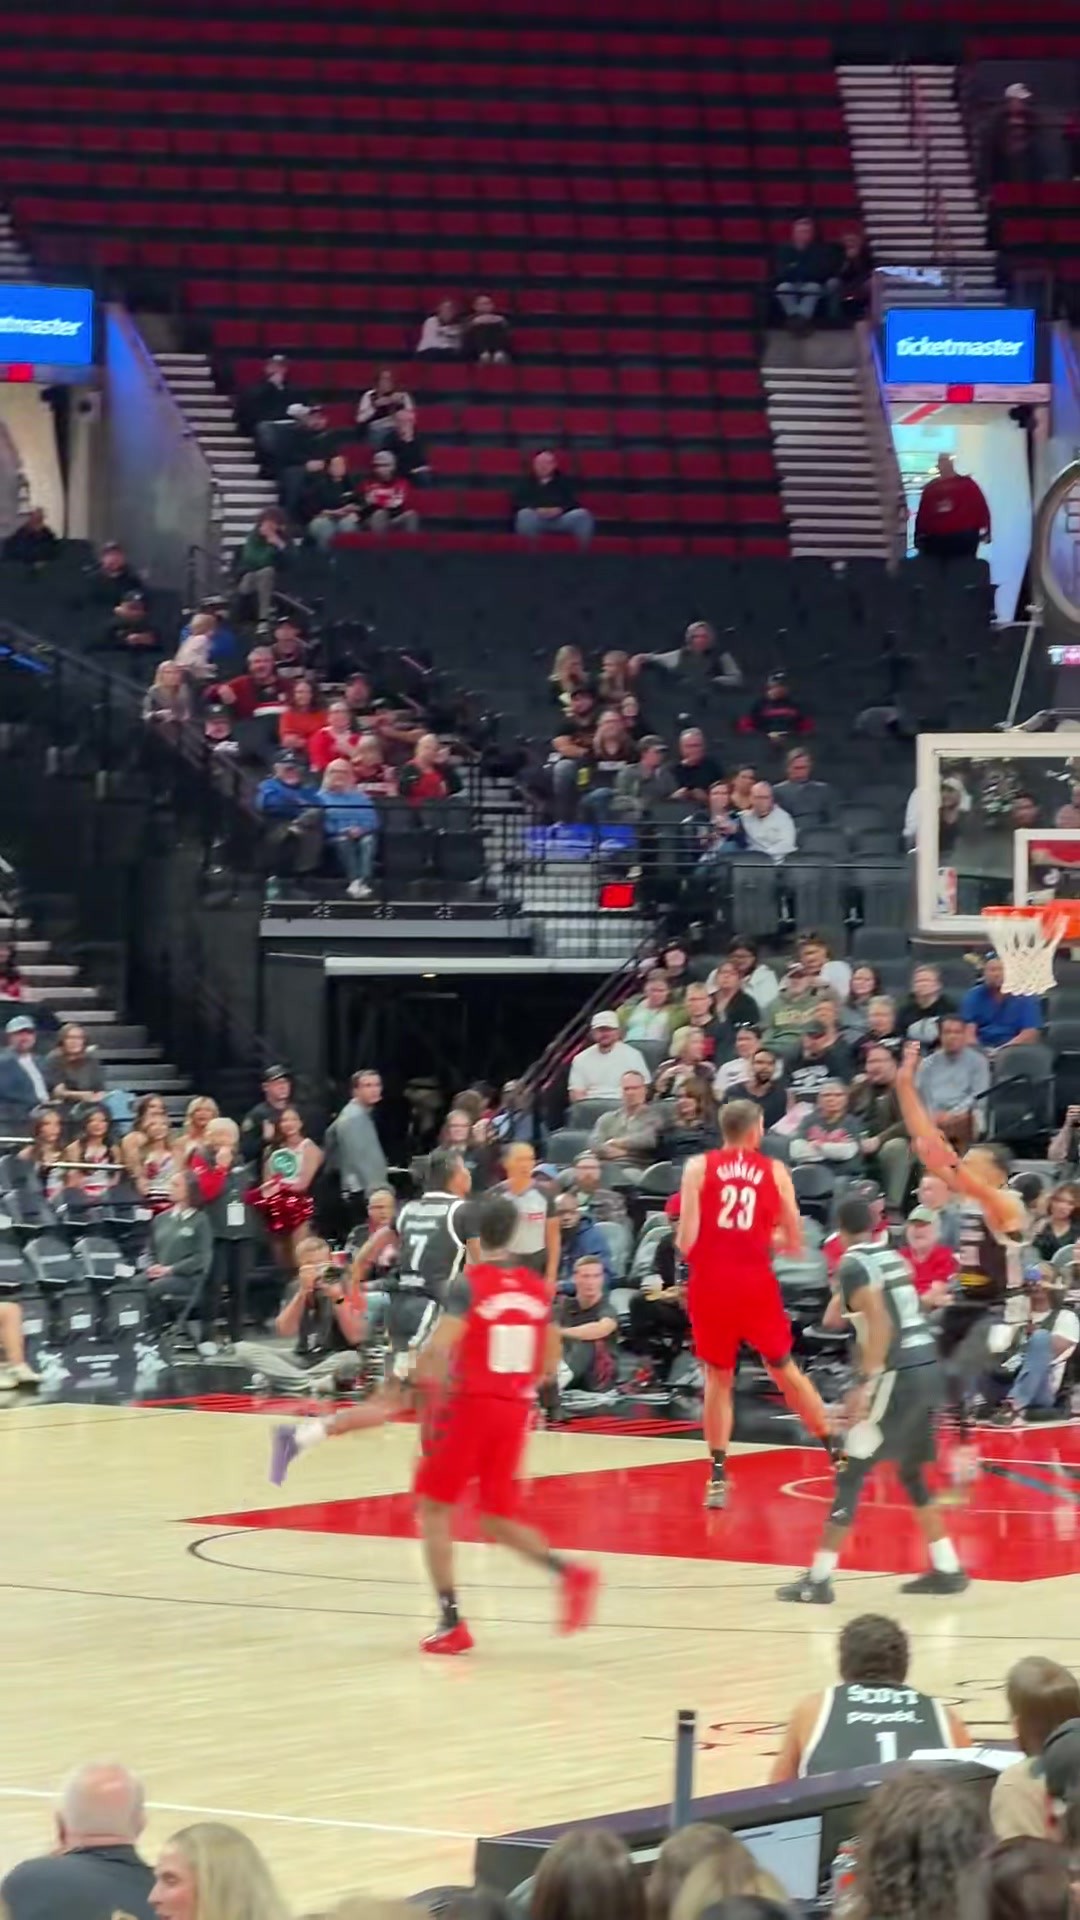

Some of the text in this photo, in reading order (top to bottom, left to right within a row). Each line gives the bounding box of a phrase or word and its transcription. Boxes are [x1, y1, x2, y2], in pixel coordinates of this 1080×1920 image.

[0, 316, 83, 336] tmaster
[896, 336, 1023, 356] ticketmaster
[717, 1184, 757, 1231] 23
[409, 1233, 428, 1271] 7
[846, 1684, 919, 1705] SCOTT
[875, 1731, 897, 1764] 1
